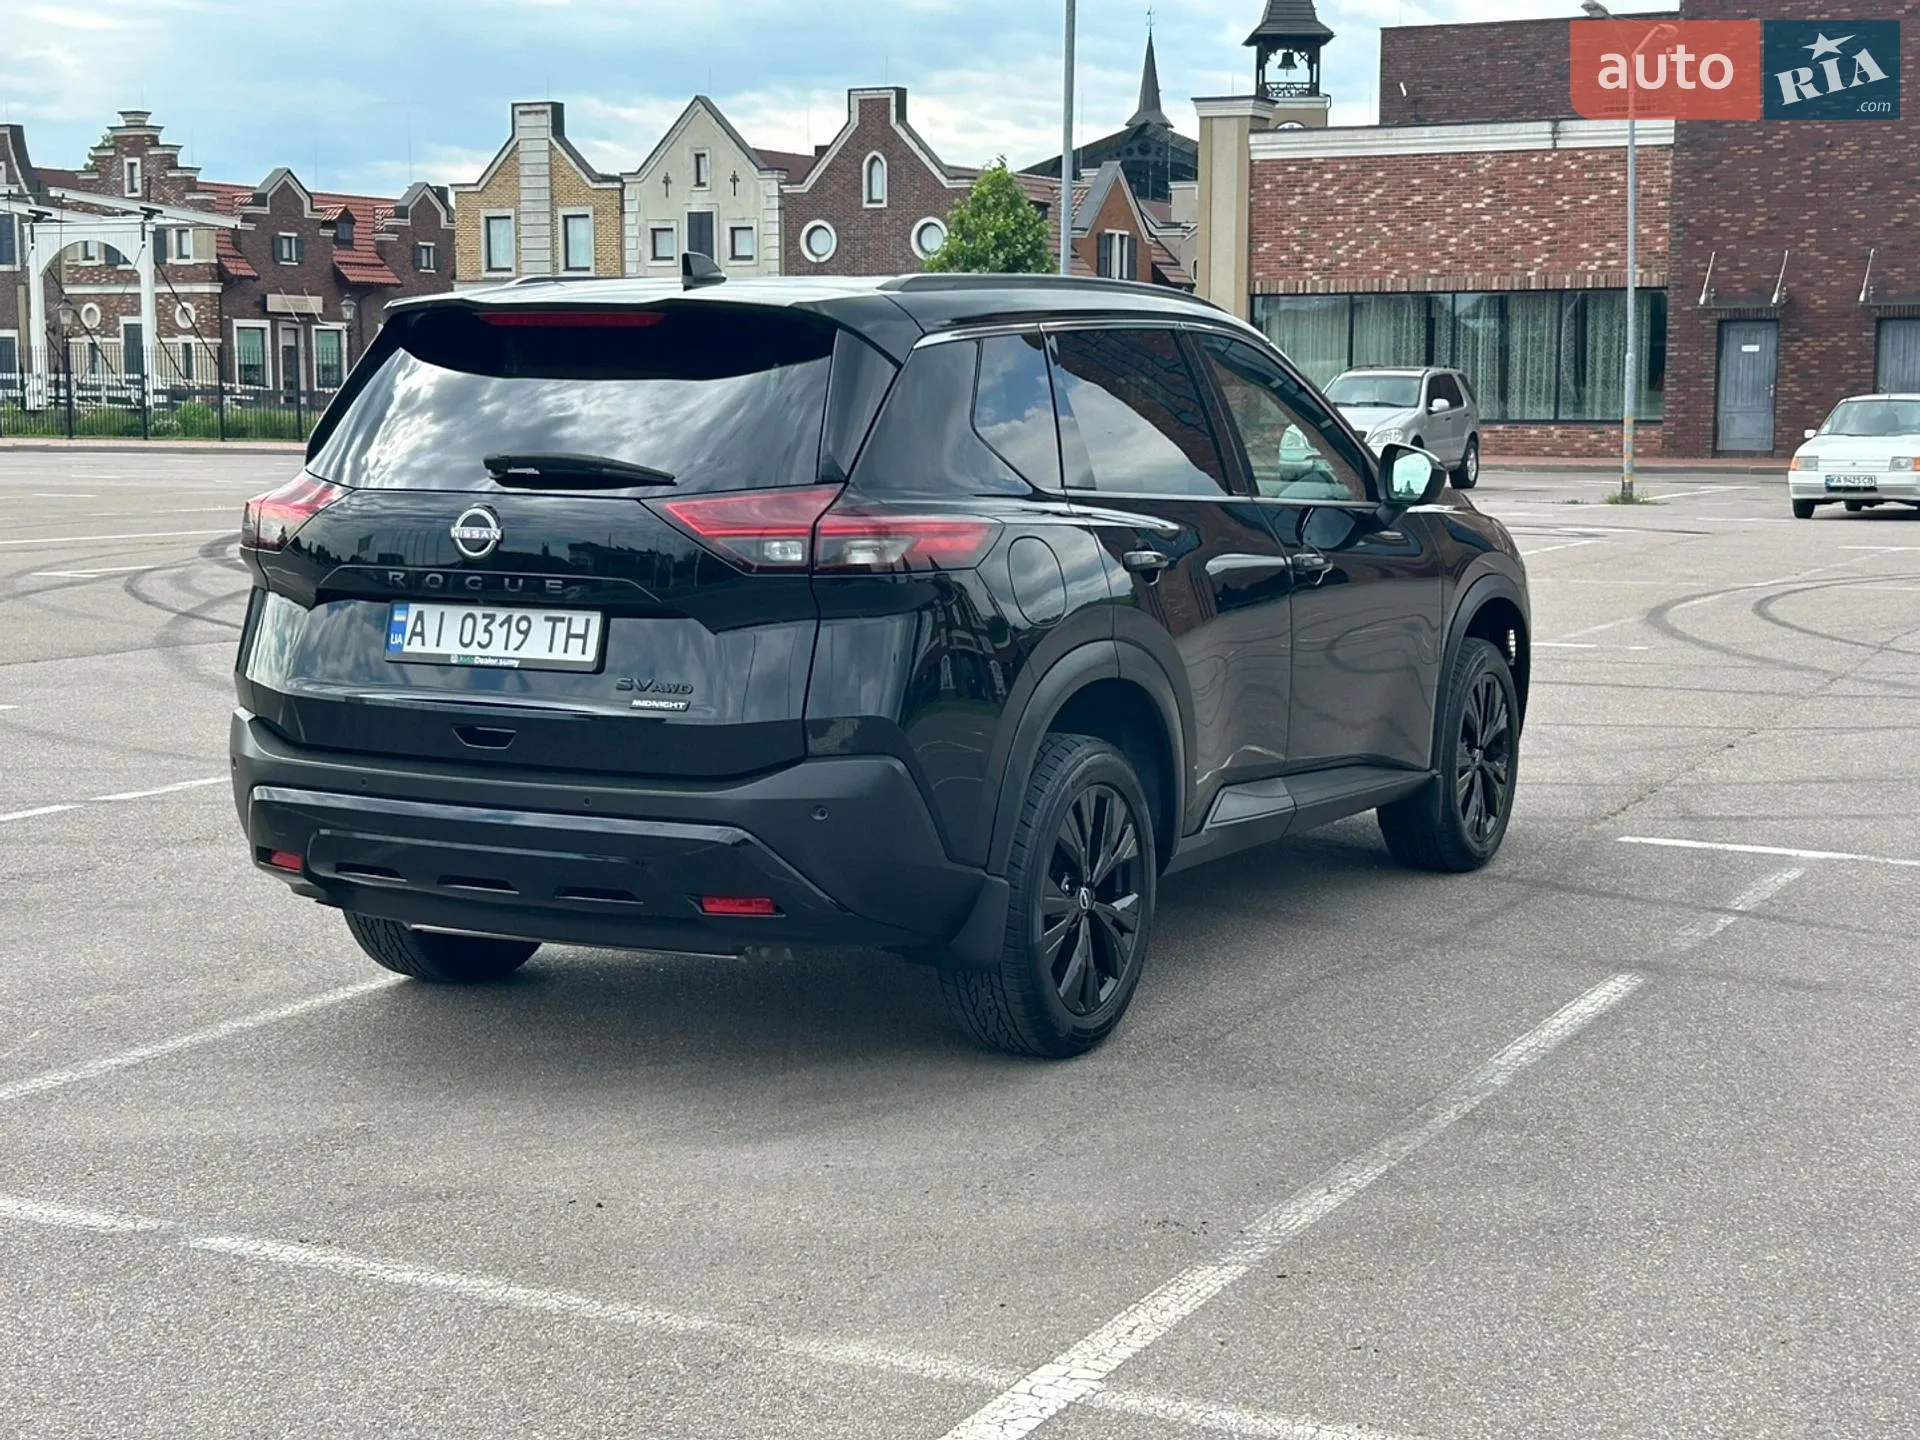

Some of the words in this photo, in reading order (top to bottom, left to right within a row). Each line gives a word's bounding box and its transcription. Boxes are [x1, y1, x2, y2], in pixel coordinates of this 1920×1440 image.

[452, 528, 501, 540] NISSAN
[388, 571, 564, 594] ROGUE
[390, 633, 403, 645] UA
[407, 610, 445, 648] AI
[458, 613, 532, 651] 0319
[543, 615, 591, 655] TH
[616, 677, 655, 692] SV
[651, 683, 694, 695] AWD
[631, 699, 686, 710] MIDNIGHT
